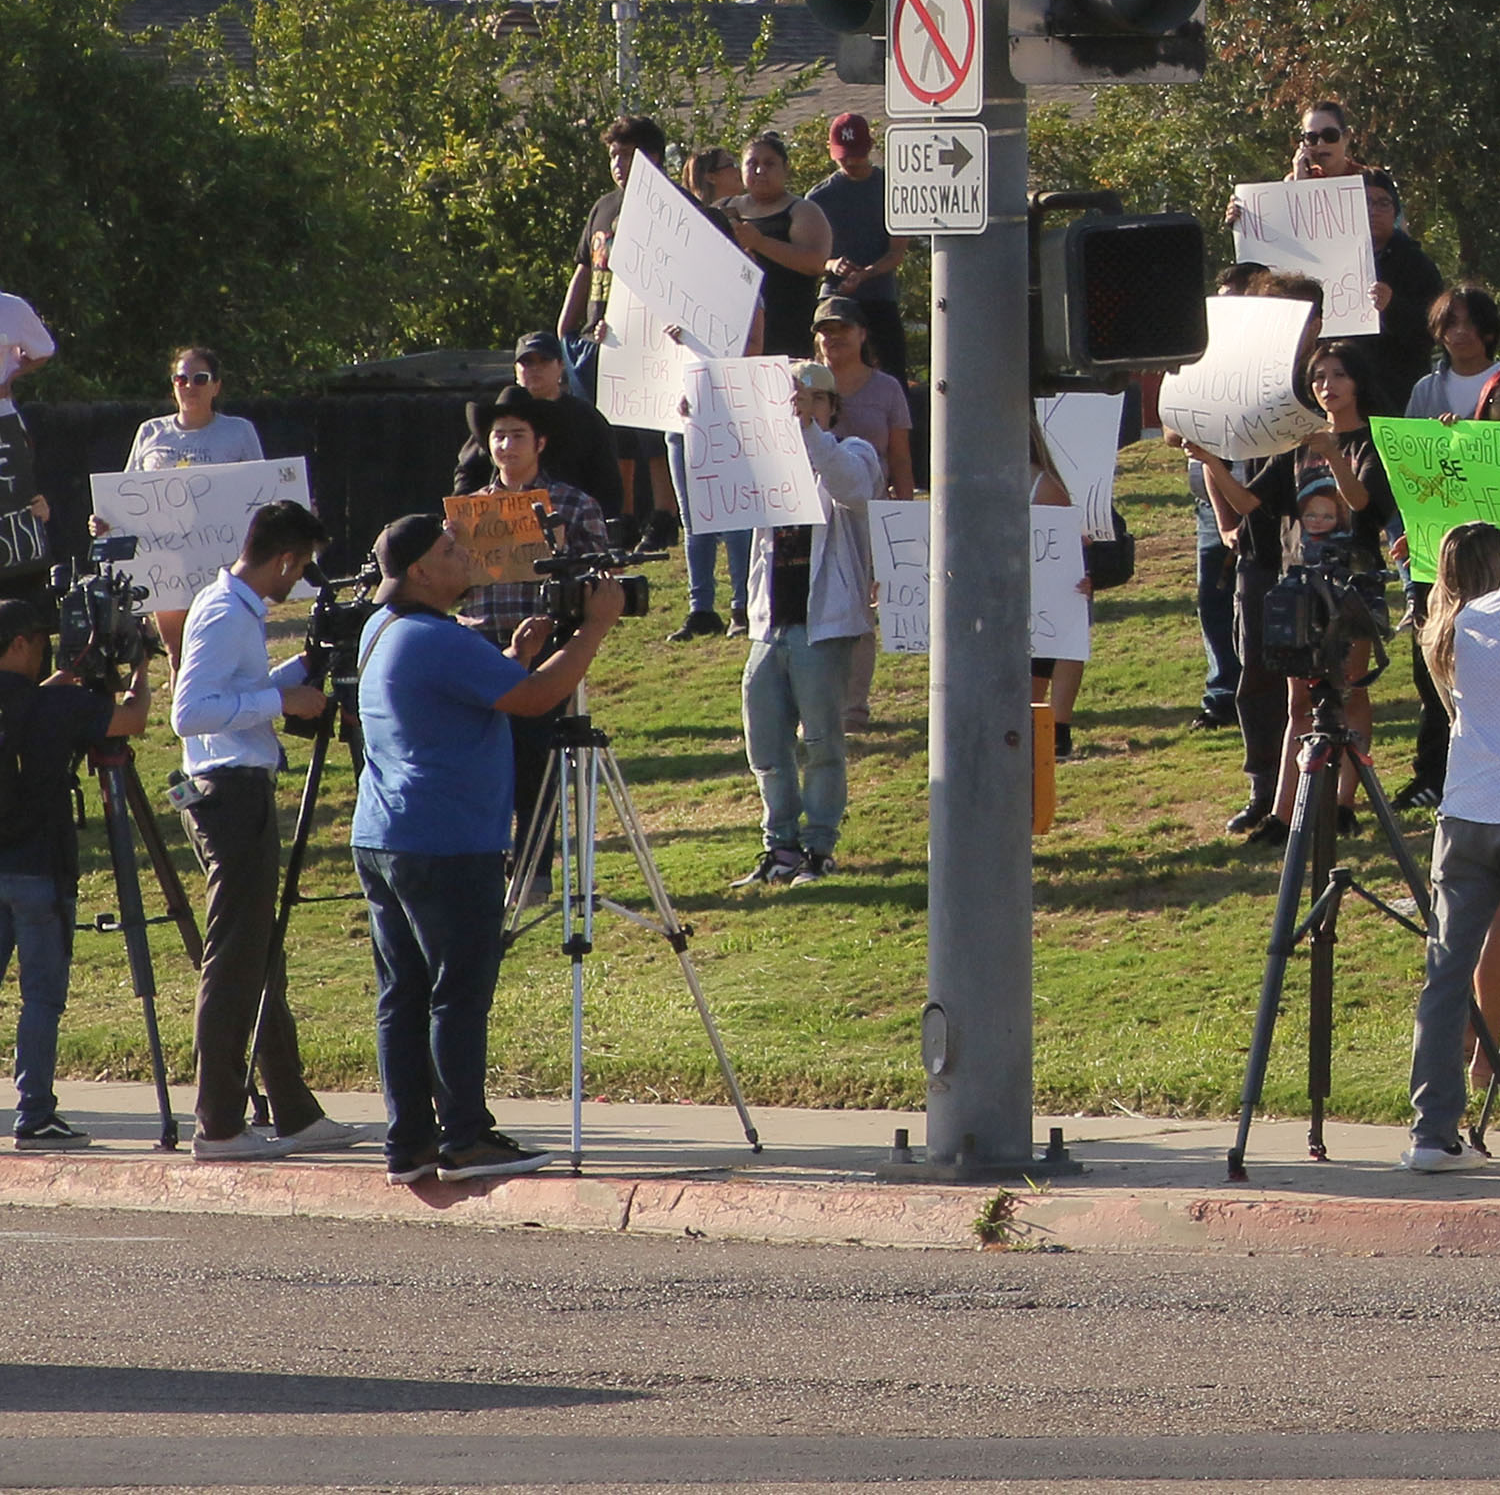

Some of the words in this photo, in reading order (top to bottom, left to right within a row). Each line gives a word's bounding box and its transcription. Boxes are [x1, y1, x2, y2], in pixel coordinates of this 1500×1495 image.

[898, 143, 934, 173] USE
[891, 184, 980, 214] CROSSWALK
[1240, 191, 1279, 243] WE
[1285, 186, 1363, 241] WANT
[687, 367, 747, 414] THE
[748, 362, 795, 410] KID
[683, 416, 801, 470] DESERVES
[1164, 405, 1277, 448] TEAM
[1439, 458, 1468, 482] BE
[116, 473, 212, 517] STOP
[695, 468, 801, 522] Justice!
